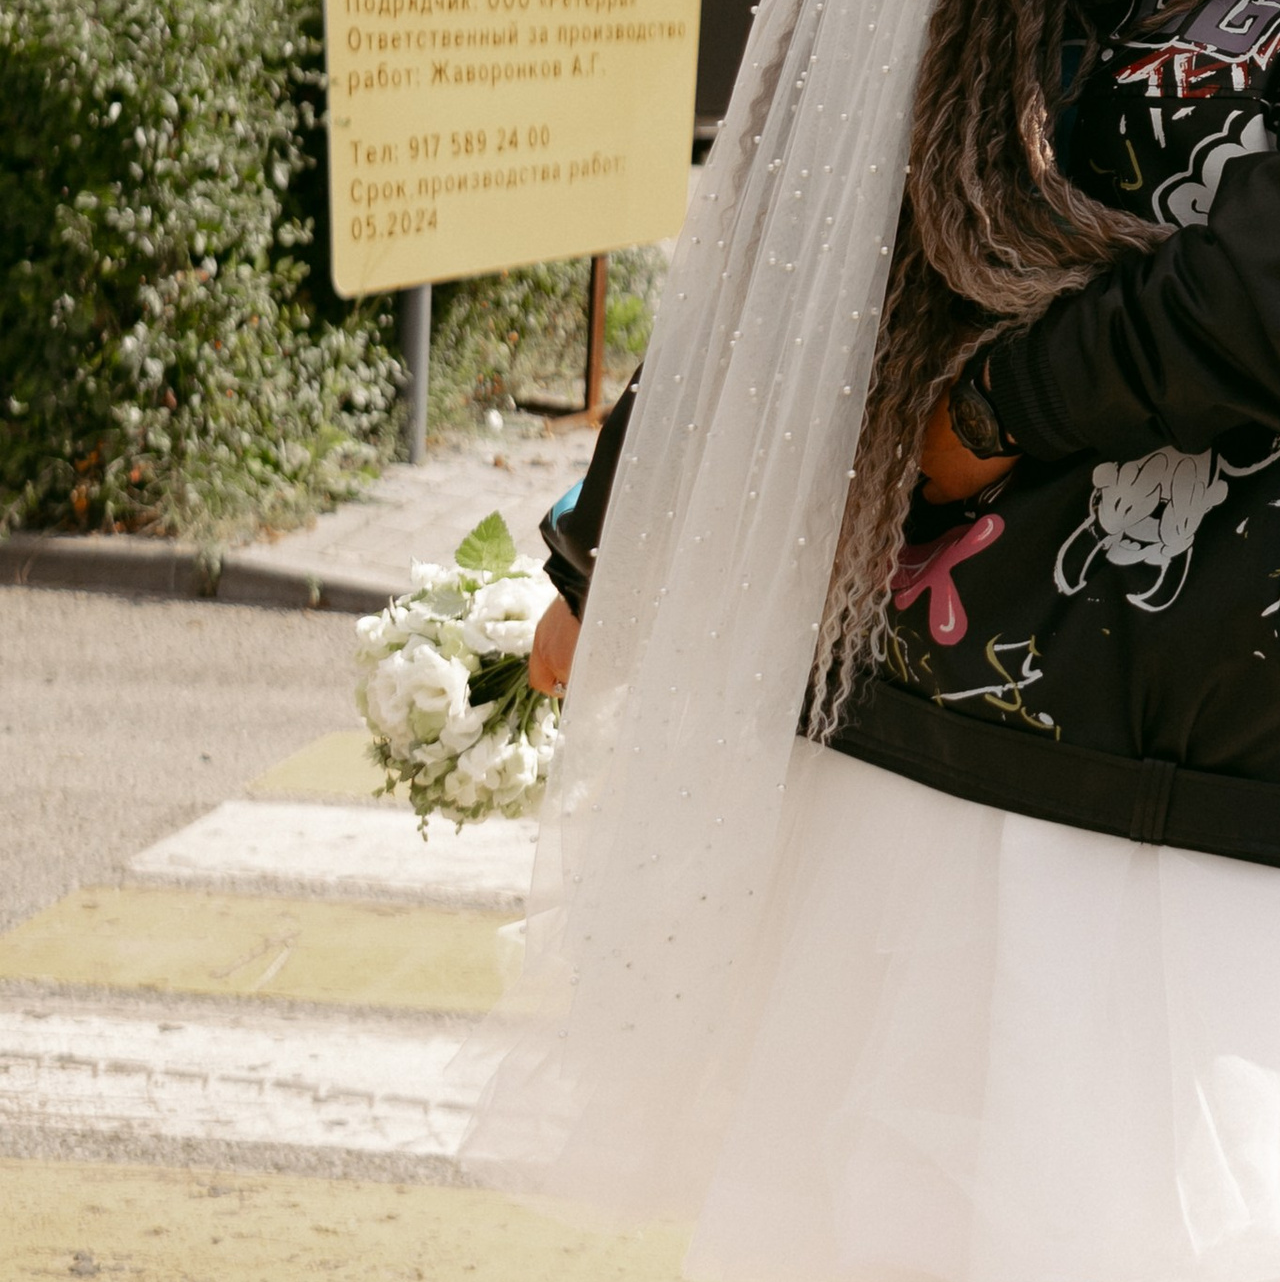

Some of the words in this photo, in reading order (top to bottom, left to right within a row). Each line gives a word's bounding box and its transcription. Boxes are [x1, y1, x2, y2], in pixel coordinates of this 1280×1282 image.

[347, 24, 520, 53] Ответственный
[528, 25, 549, 45] за
[558, 22, 686, 48] производство
[348, 61, 420, 97] работ:
[431, 59, 563, 86] Жаворонков
[350, 140, 398, 166] Тел:
[409, 133, 440, 159] 917
[451, 129, 487, 157] 589
[496, 126, 519, 151] 24
[528, 123, 551, 149] 00
[417, 161, 561, 199] производства
[569, 152, 626, 183] работ:
[350, 209, 439, 240] 05.2024
